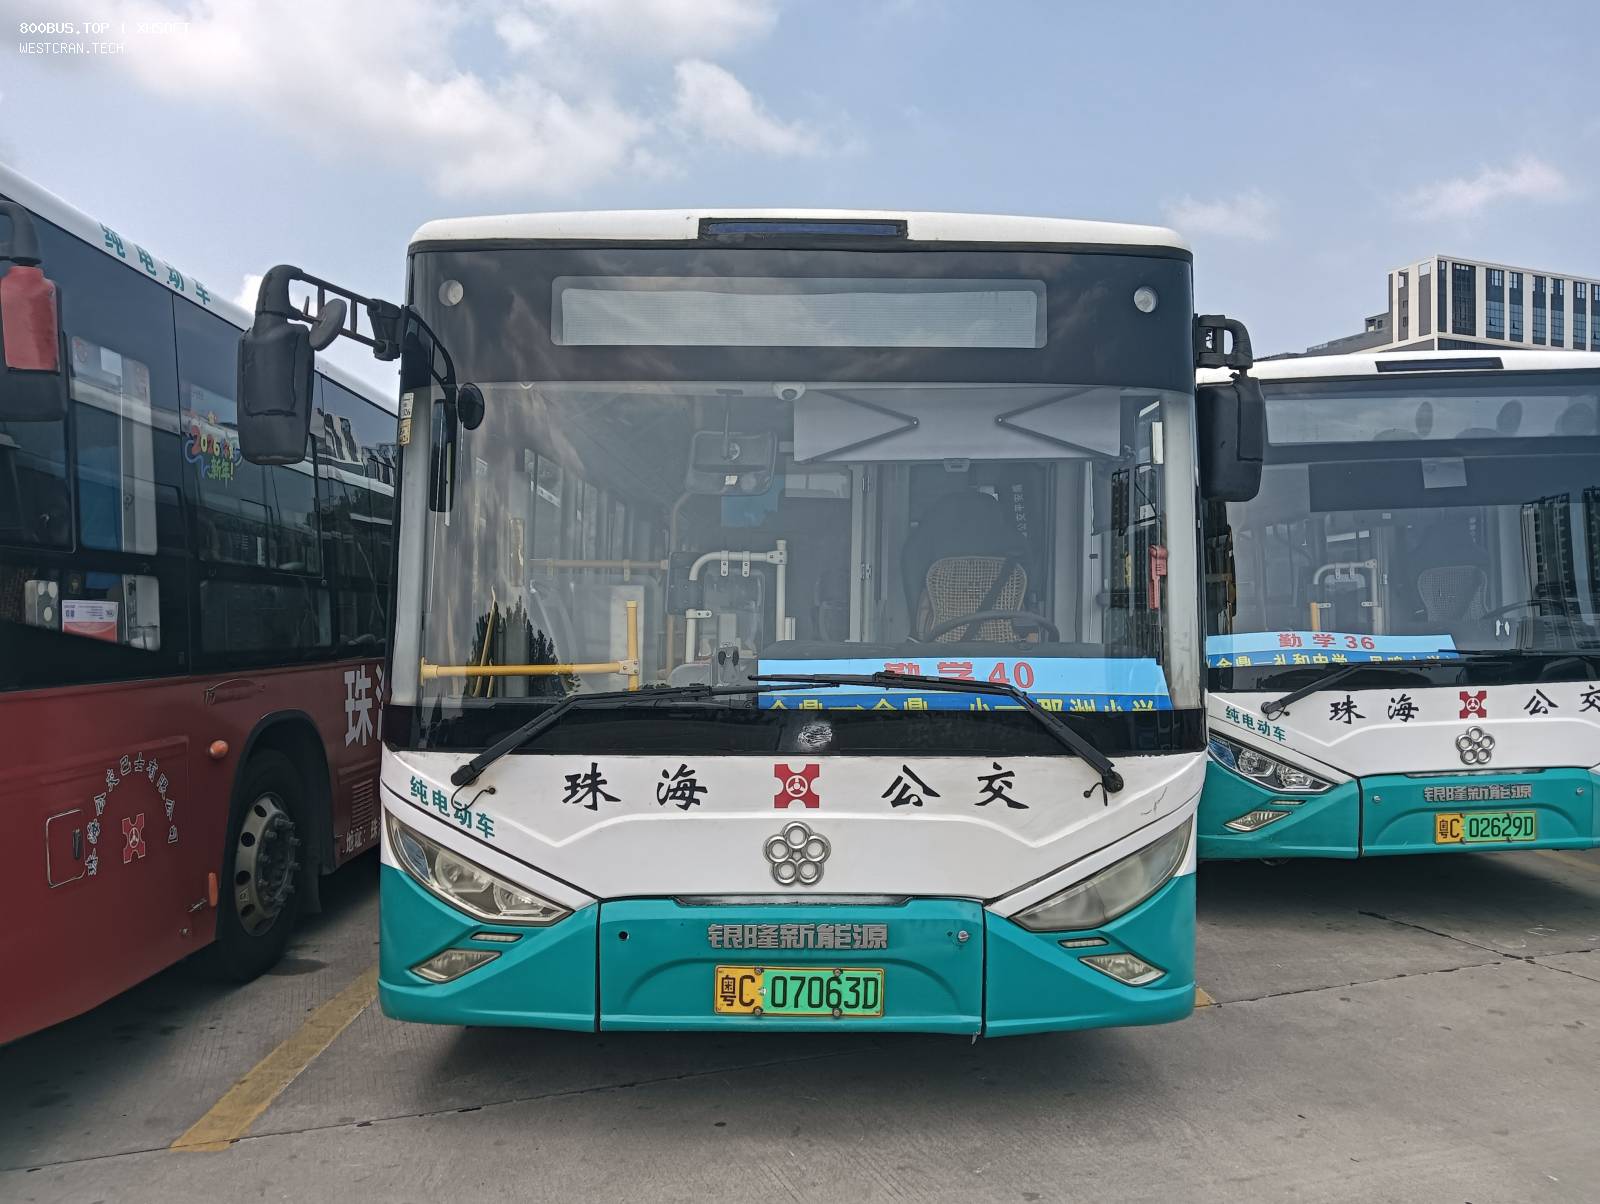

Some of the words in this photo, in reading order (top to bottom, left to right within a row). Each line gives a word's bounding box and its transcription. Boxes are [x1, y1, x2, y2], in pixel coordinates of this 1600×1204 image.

[100, 222, 211, 305] 纯电动车
[1278, 633, 1375, 650] 勤学36
[1225, 705, 1287, 742] 纯电动车
[1329, 695, 1420, 724] 珠海
[1523, 685, 1600, 716] 公交
[562, 762, 708, 811] 珠海
[881, 762, 1029, 809] 公交
[1423, 784, 1533, 802] 银隆新能源
[410, 775, 496, 839] 纯电动车
[708, 923, 888, 950] 银隆新能源
